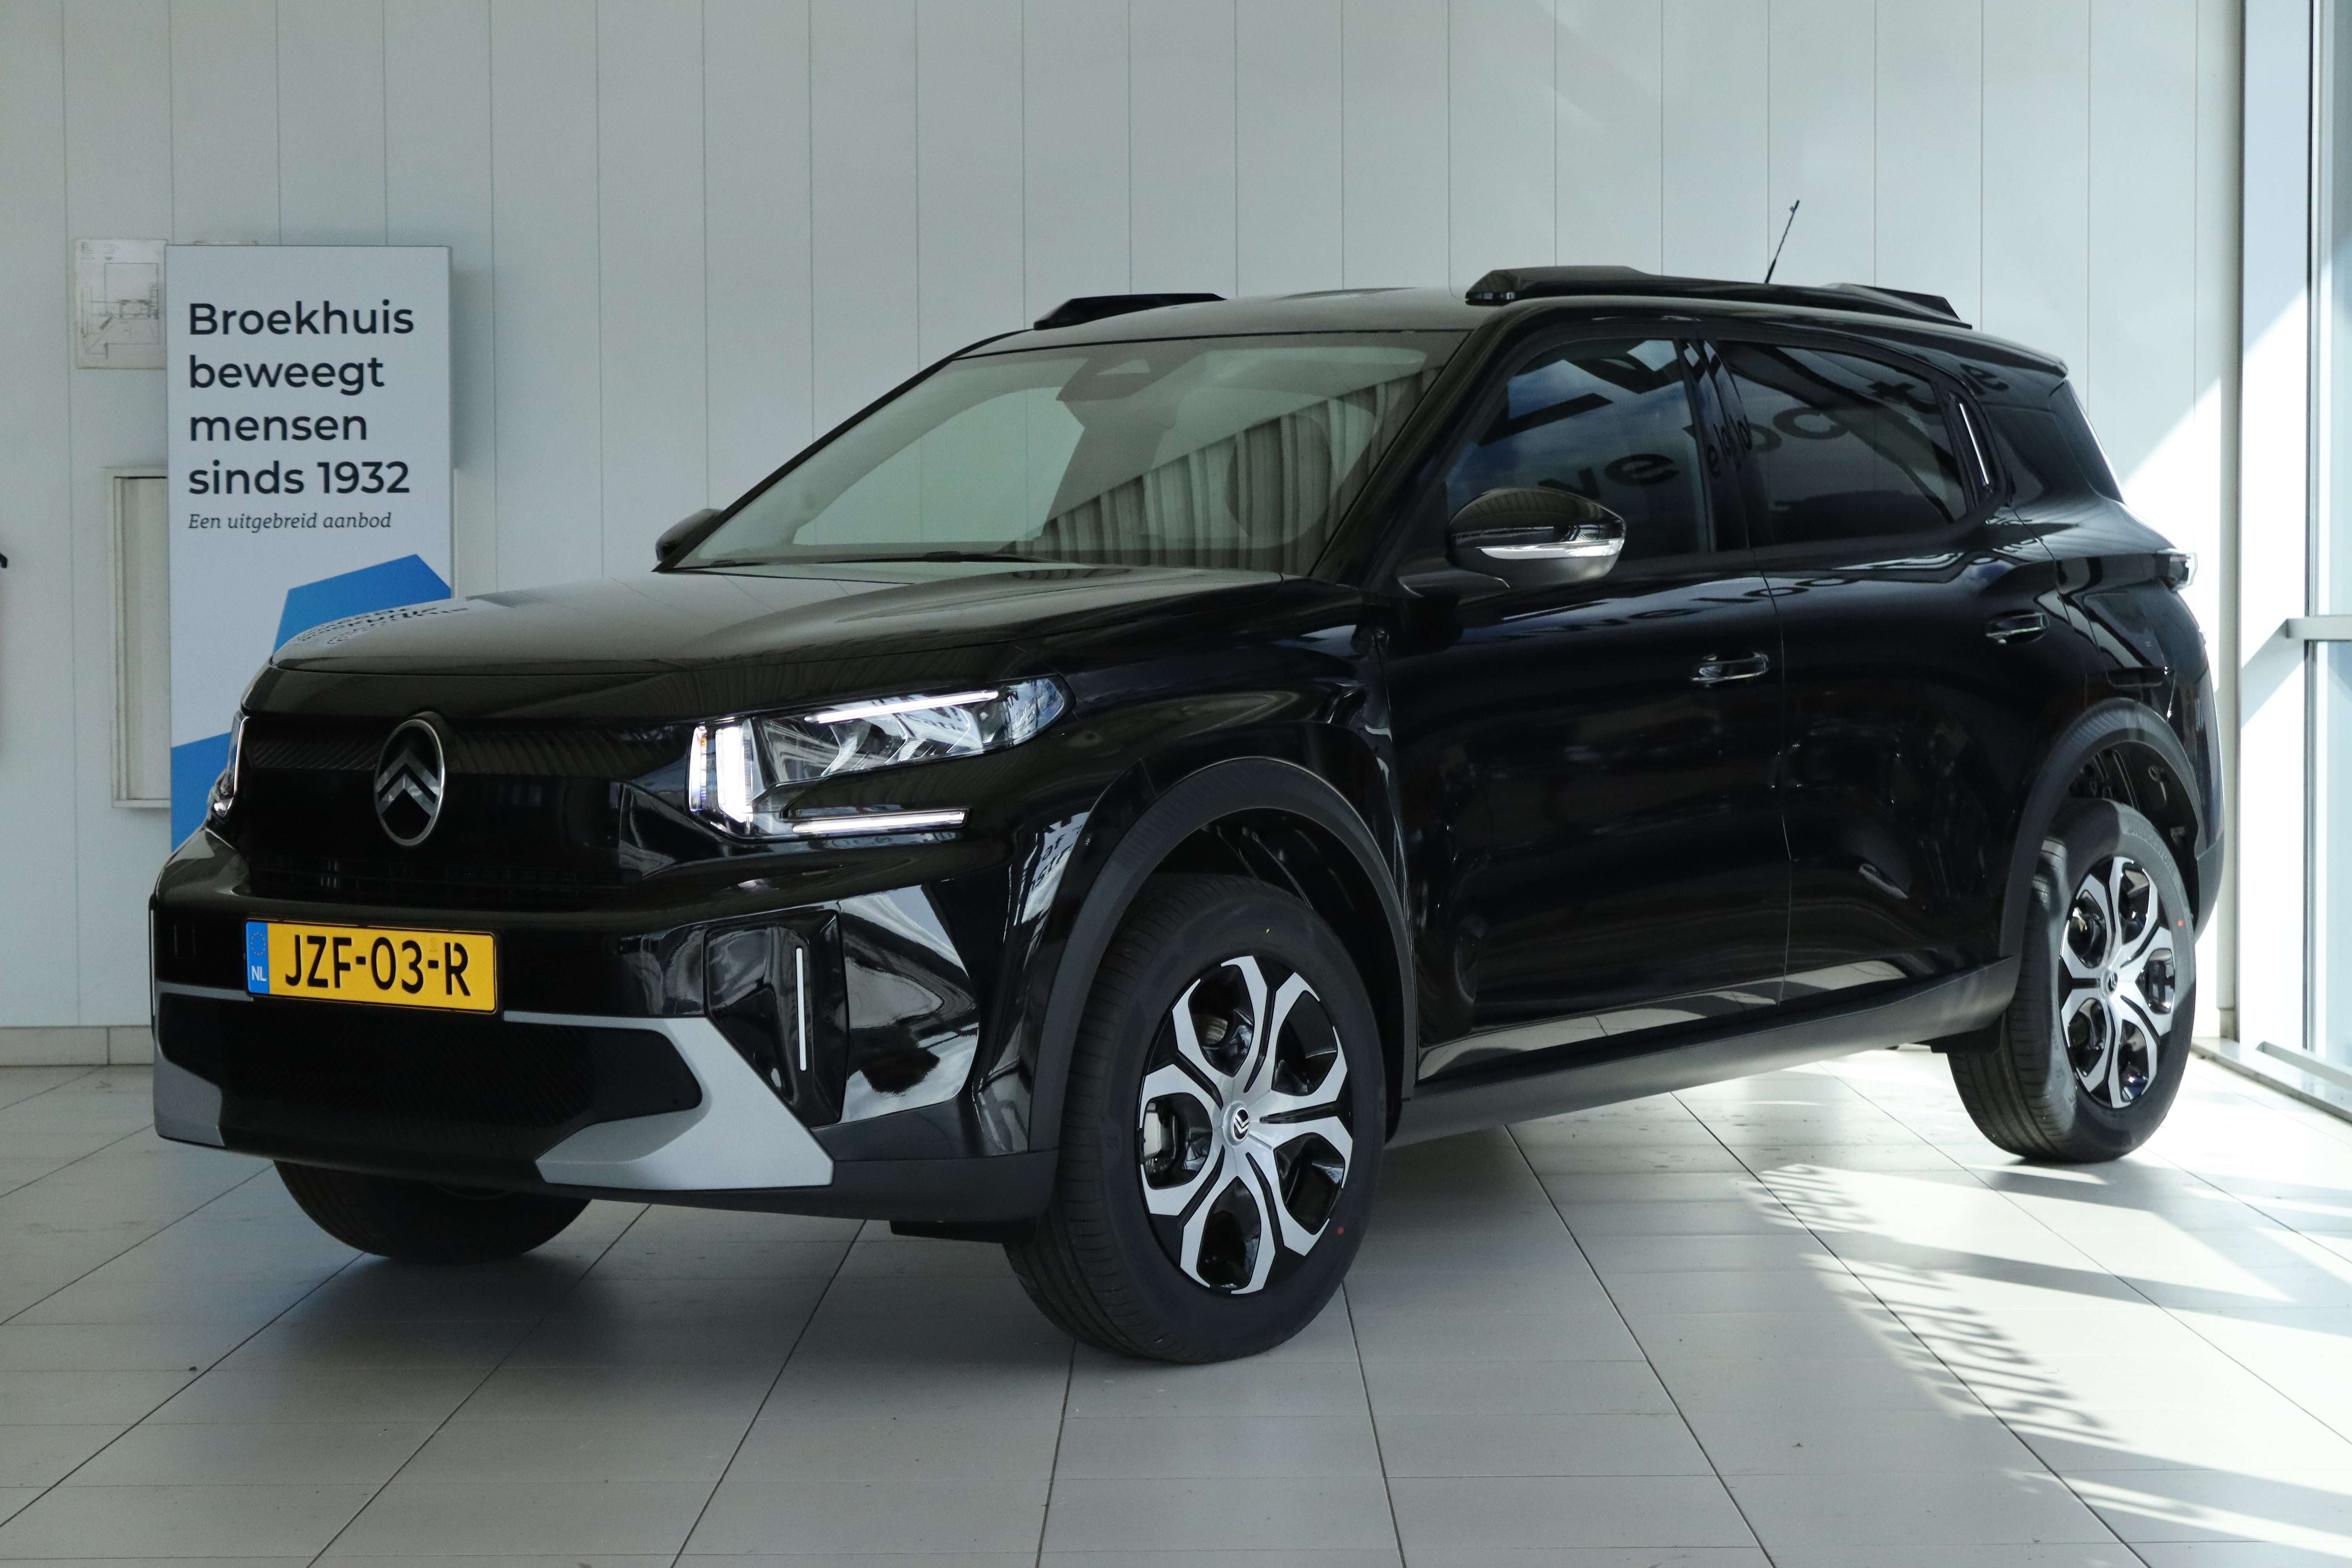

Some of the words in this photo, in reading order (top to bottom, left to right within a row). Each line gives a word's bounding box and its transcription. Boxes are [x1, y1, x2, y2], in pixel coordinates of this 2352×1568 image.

[190, 299, 413, 335] Broekhuis
[190, 355, 384, 396] beweegt
[191, 416, 366, 441] mensen
[189, 460, 304, 494] sinds
[317, 461, 409, 494] 1932
[188, 514, 220, 528] Een
[228, 513, 317, 533] uitgebreid
[323, 512, 391, 528] aanbod
[252, 966, 266, 981] NL
[285, 935, 470, 996] JZF-03-R
